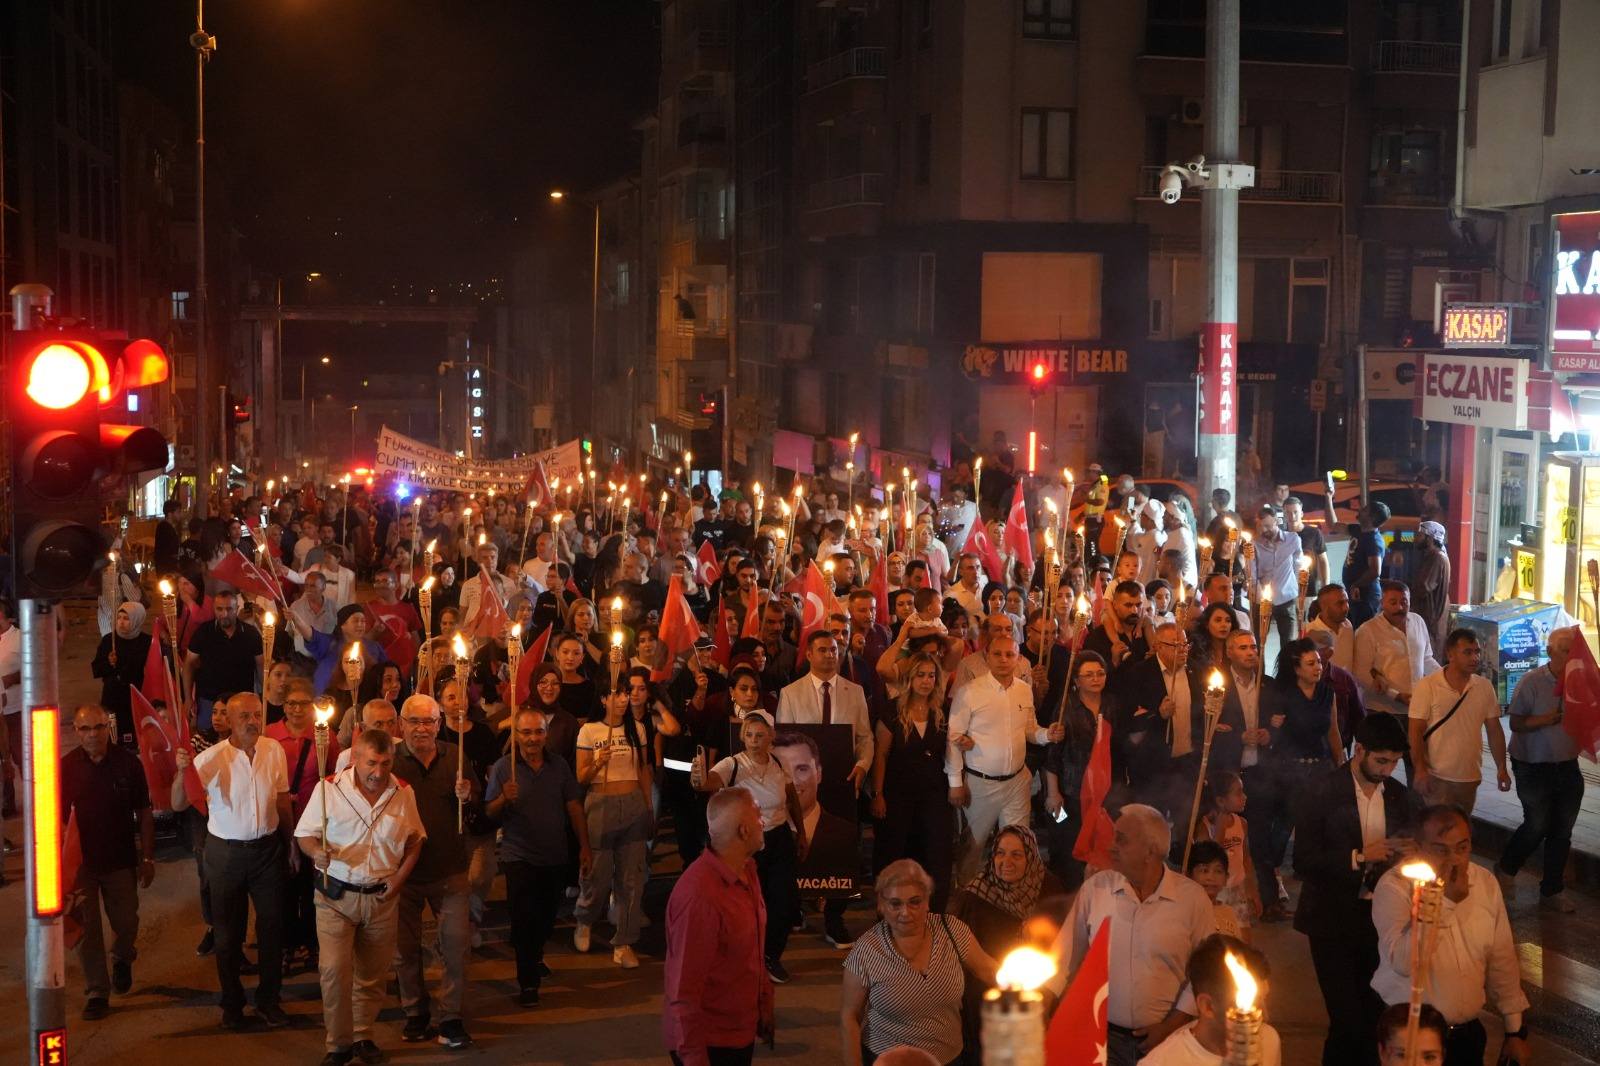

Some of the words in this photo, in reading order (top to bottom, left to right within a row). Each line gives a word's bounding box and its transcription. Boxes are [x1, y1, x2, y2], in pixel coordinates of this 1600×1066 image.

[1448, 313, 1503, 339] KASAP
[1077, 350, 1128, 372] BEAR
[1559, 357, 1587, 369] KASAP
[1220, 333, 1233, 424] KASAP
[1426, 363, 1514, 403] ECZANE
[1453, 405, 1481, 419] YALÇIN
[1562, 519, 1576, 540] 10
[1521, 567, 1534, 587] 10
[1504, 660, 1530, 669] damla
